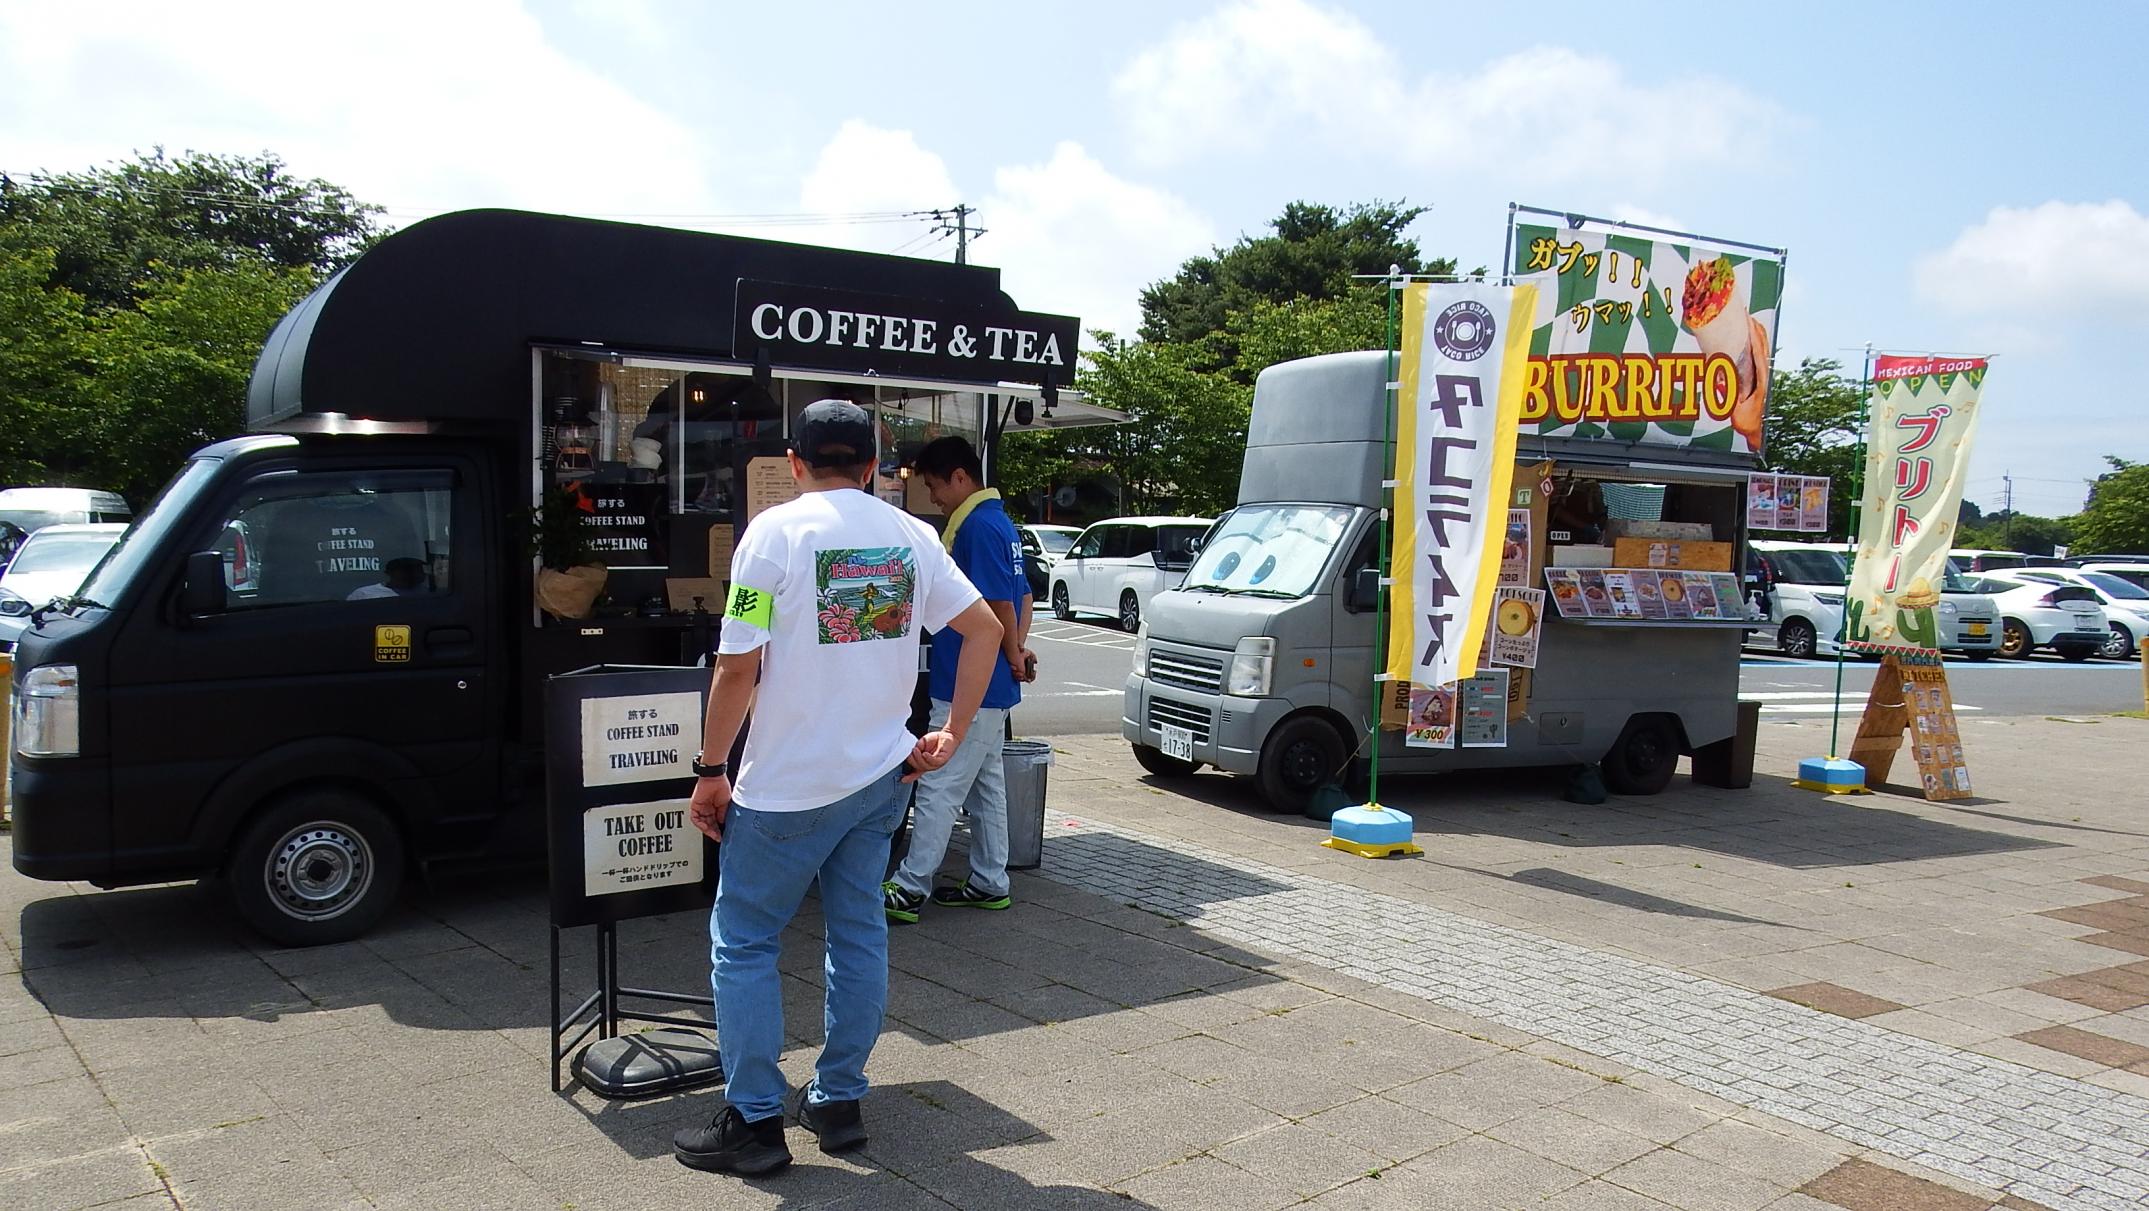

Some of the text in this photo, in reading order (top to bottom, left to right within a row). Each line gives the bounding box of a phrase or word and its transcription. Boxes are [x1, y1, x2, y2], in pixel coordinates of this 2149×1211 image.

[751, 303, 1064, 365] COFFEE & TEA
[1877, 360, 1973, 379] MEXICAN FOOD
[1518, 355, 1739, 422] BURRITO
[1880, 368, 1982, 395] OPEN
[1883, 404, 1952, 594] ブリトー
[615, 516, 646, 526] STAND
[348, 539, 375, 549] STAND
[315, 557, 380, 573] TAVELING
[627, 709, 658, 720] 旅する
[607, 723, 679, 741] COFFEE STAND
[609, 749, 678, 769] TRAVELING
[604, 810, 684, 836] TAKE OUT
[618, 834, 673, 857] COFFEE
